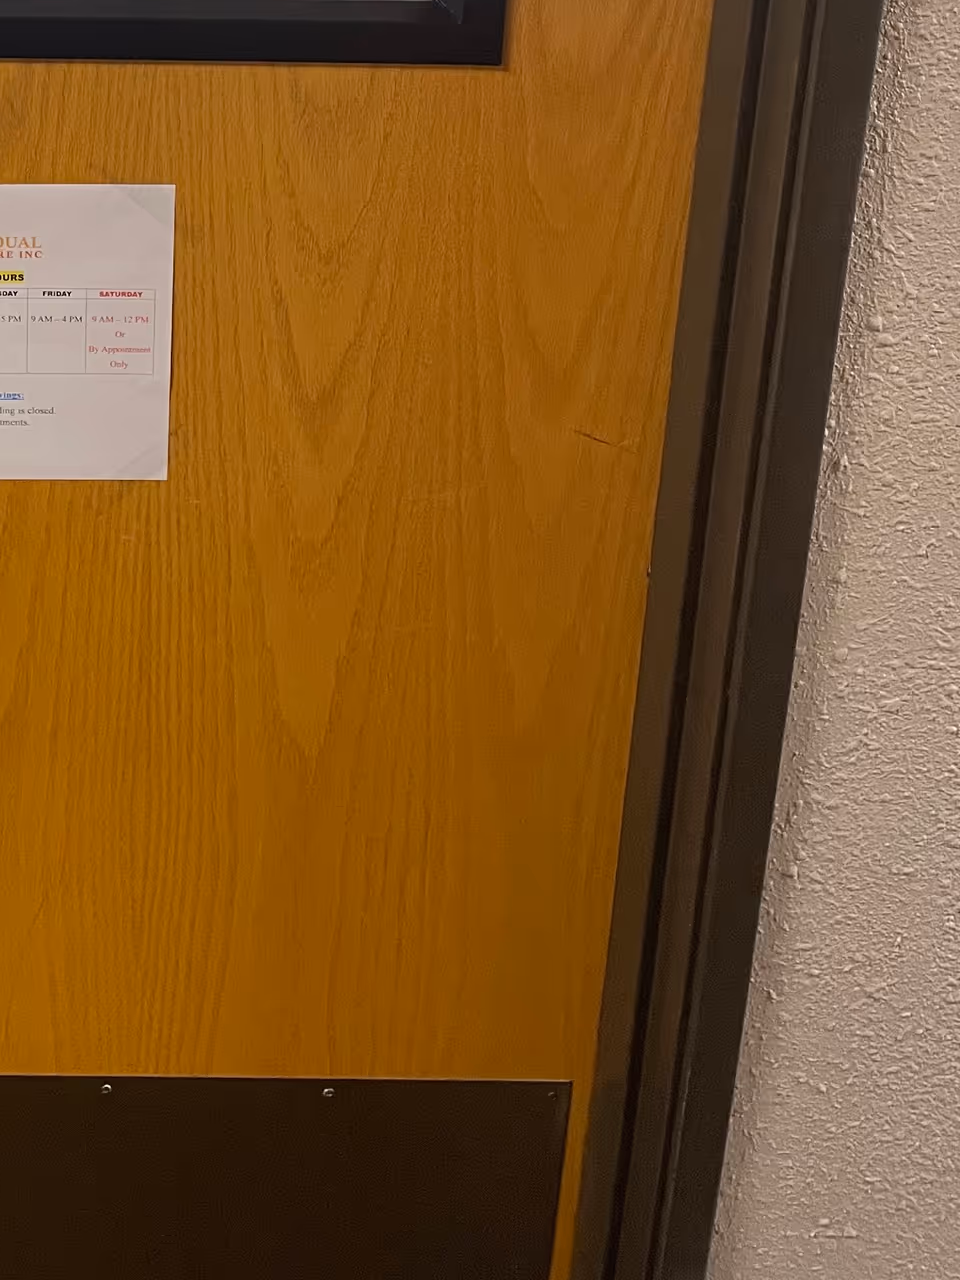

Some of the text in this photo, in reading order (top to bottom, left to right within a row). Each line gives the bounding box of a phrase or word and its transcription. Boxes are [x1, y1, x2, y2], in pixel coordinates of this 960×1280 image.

[19, 250, 43, 258] INC
[110, 360, 128, 368] Only
[28, 406, 56, 414] closed.
